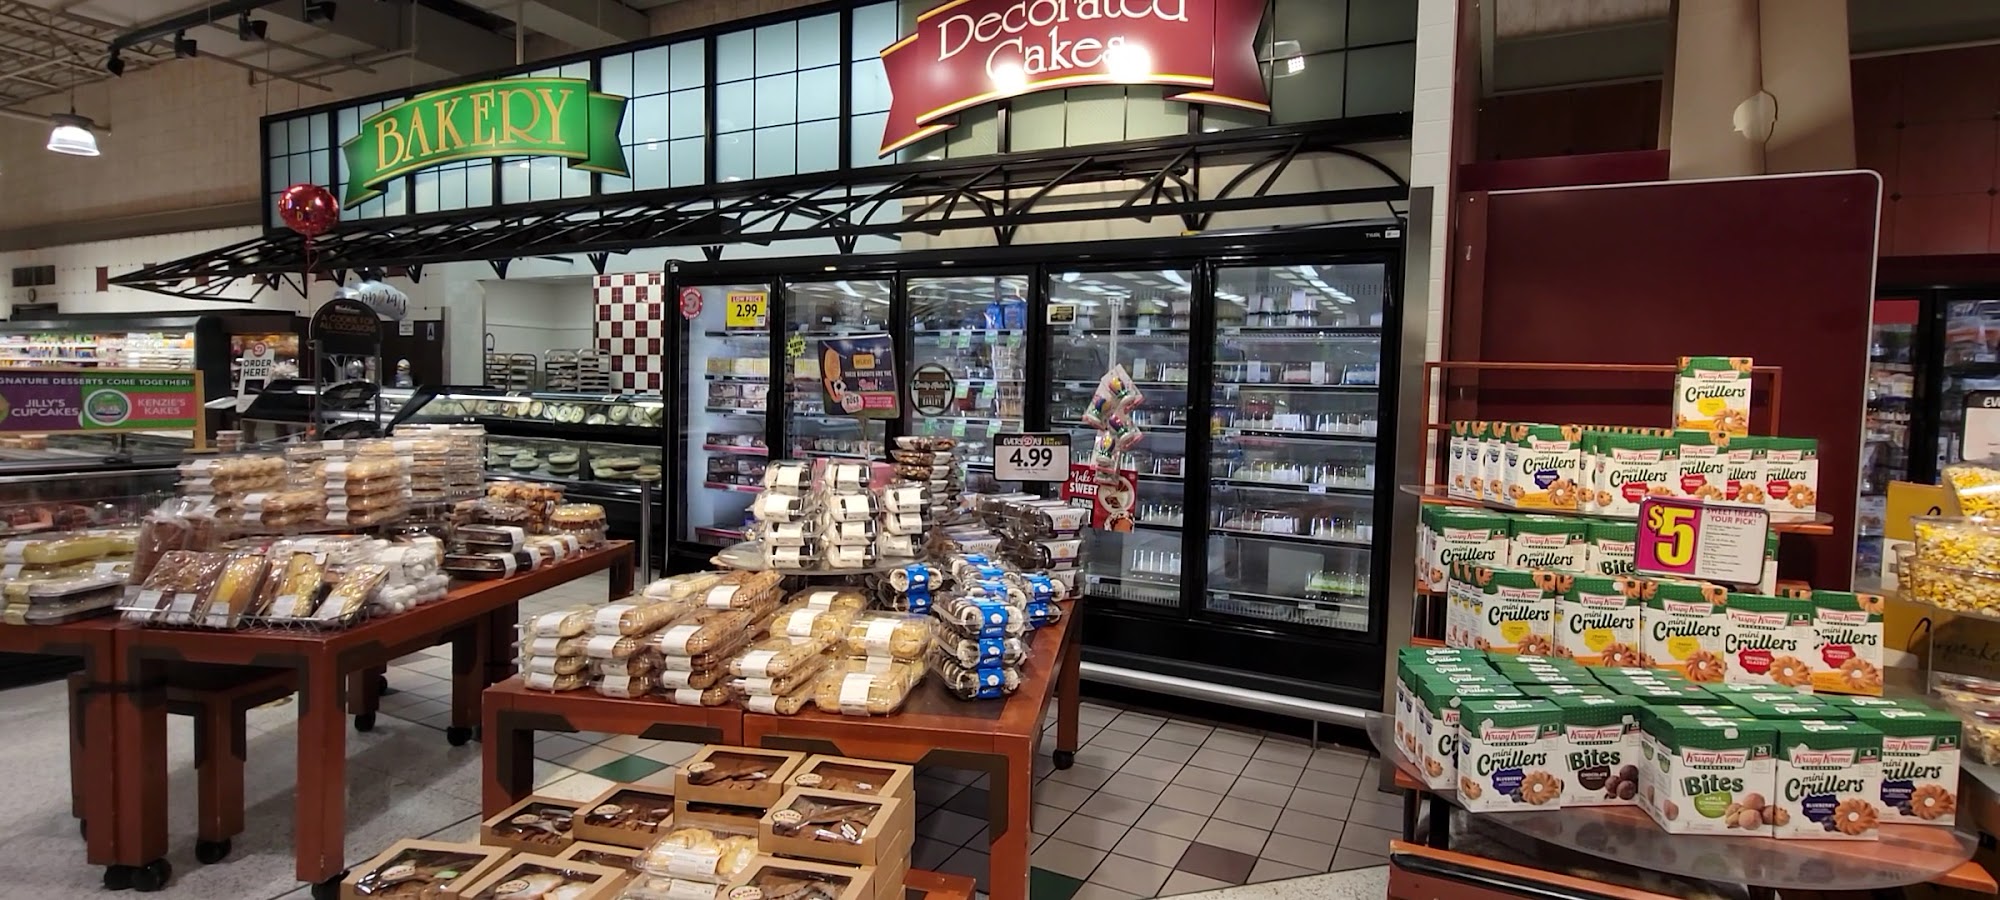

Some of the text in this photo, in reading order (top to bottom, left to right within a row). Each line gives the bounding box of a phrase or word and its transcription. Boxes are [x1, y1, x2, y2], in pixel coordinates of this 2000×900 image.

[937, 0, 1188, 62] Decorated
[985, 26, 1127, 77] Cakes
[375, 88, 574, 172] BAKERY
[736, 304, 758, 317] 2.99
[243, 359, 272, 368] ORDER
[243, 368, 269, 377] HERE!
[52, 377, 104, 386] DESSERTS
[106, 377, 136, 386] COME
[139, 378, 190, 386] TOGETHER!
[1685, 385, 1746, 402] Crullers
[25, 398, 66, 409] JILLY'S
[138, 397, 186, 408] KENZIE'S
[11, 407, 78, 417] CUPCAKES
[144, 406, 181, 416] KAKES
[1010, 448, 1053, 467] 4.99
[1523, 456, 1576, 475] Crullers
[1680, 461, 1724, 476] rullers
[1070, 470, 1092, 482] Make
[1609, 469, 1668, 487] Crullers
[1766, 468, 1807, 481] rullers
[1069, 482, 1099, 496] SWEET
[1706, 508, 1763, 518] SWEET TREATS
[1710, 514, 1757, 526] YOUR PICK!
[1648, 504, 1696, 566] $5
[1440, 547, 1496, 565] Crullers
[1517, 553, 1574, 567] Crullers
[1601, 559, 1634, 575] Bite
[1488, 606, 1550, 626] Crullers
[1584, 610, 1602, 618] mini
[1570, 613, 1635, 634] Crullers
[1822, 626, 1842, 634] mini
[1653, 621, 1721, 641] Crullers
[1738, 631, 1760, 639] mini
[1725, 634, 1798, 654] Crullers
[1492, 748, 1512, 758] mini
[1569, 749, 1620, 771] Bites
[1686, 752, 1744, 764] Krispy Kreme
[1477, 750, 1547, 776] Crullers
[1803, 772, 1824, 783] mini
[1882, 761, 1942, 781] rullers
[1685, 774, 1744, 796] Bites
[1785, 775, 1864, 802] Crullers
